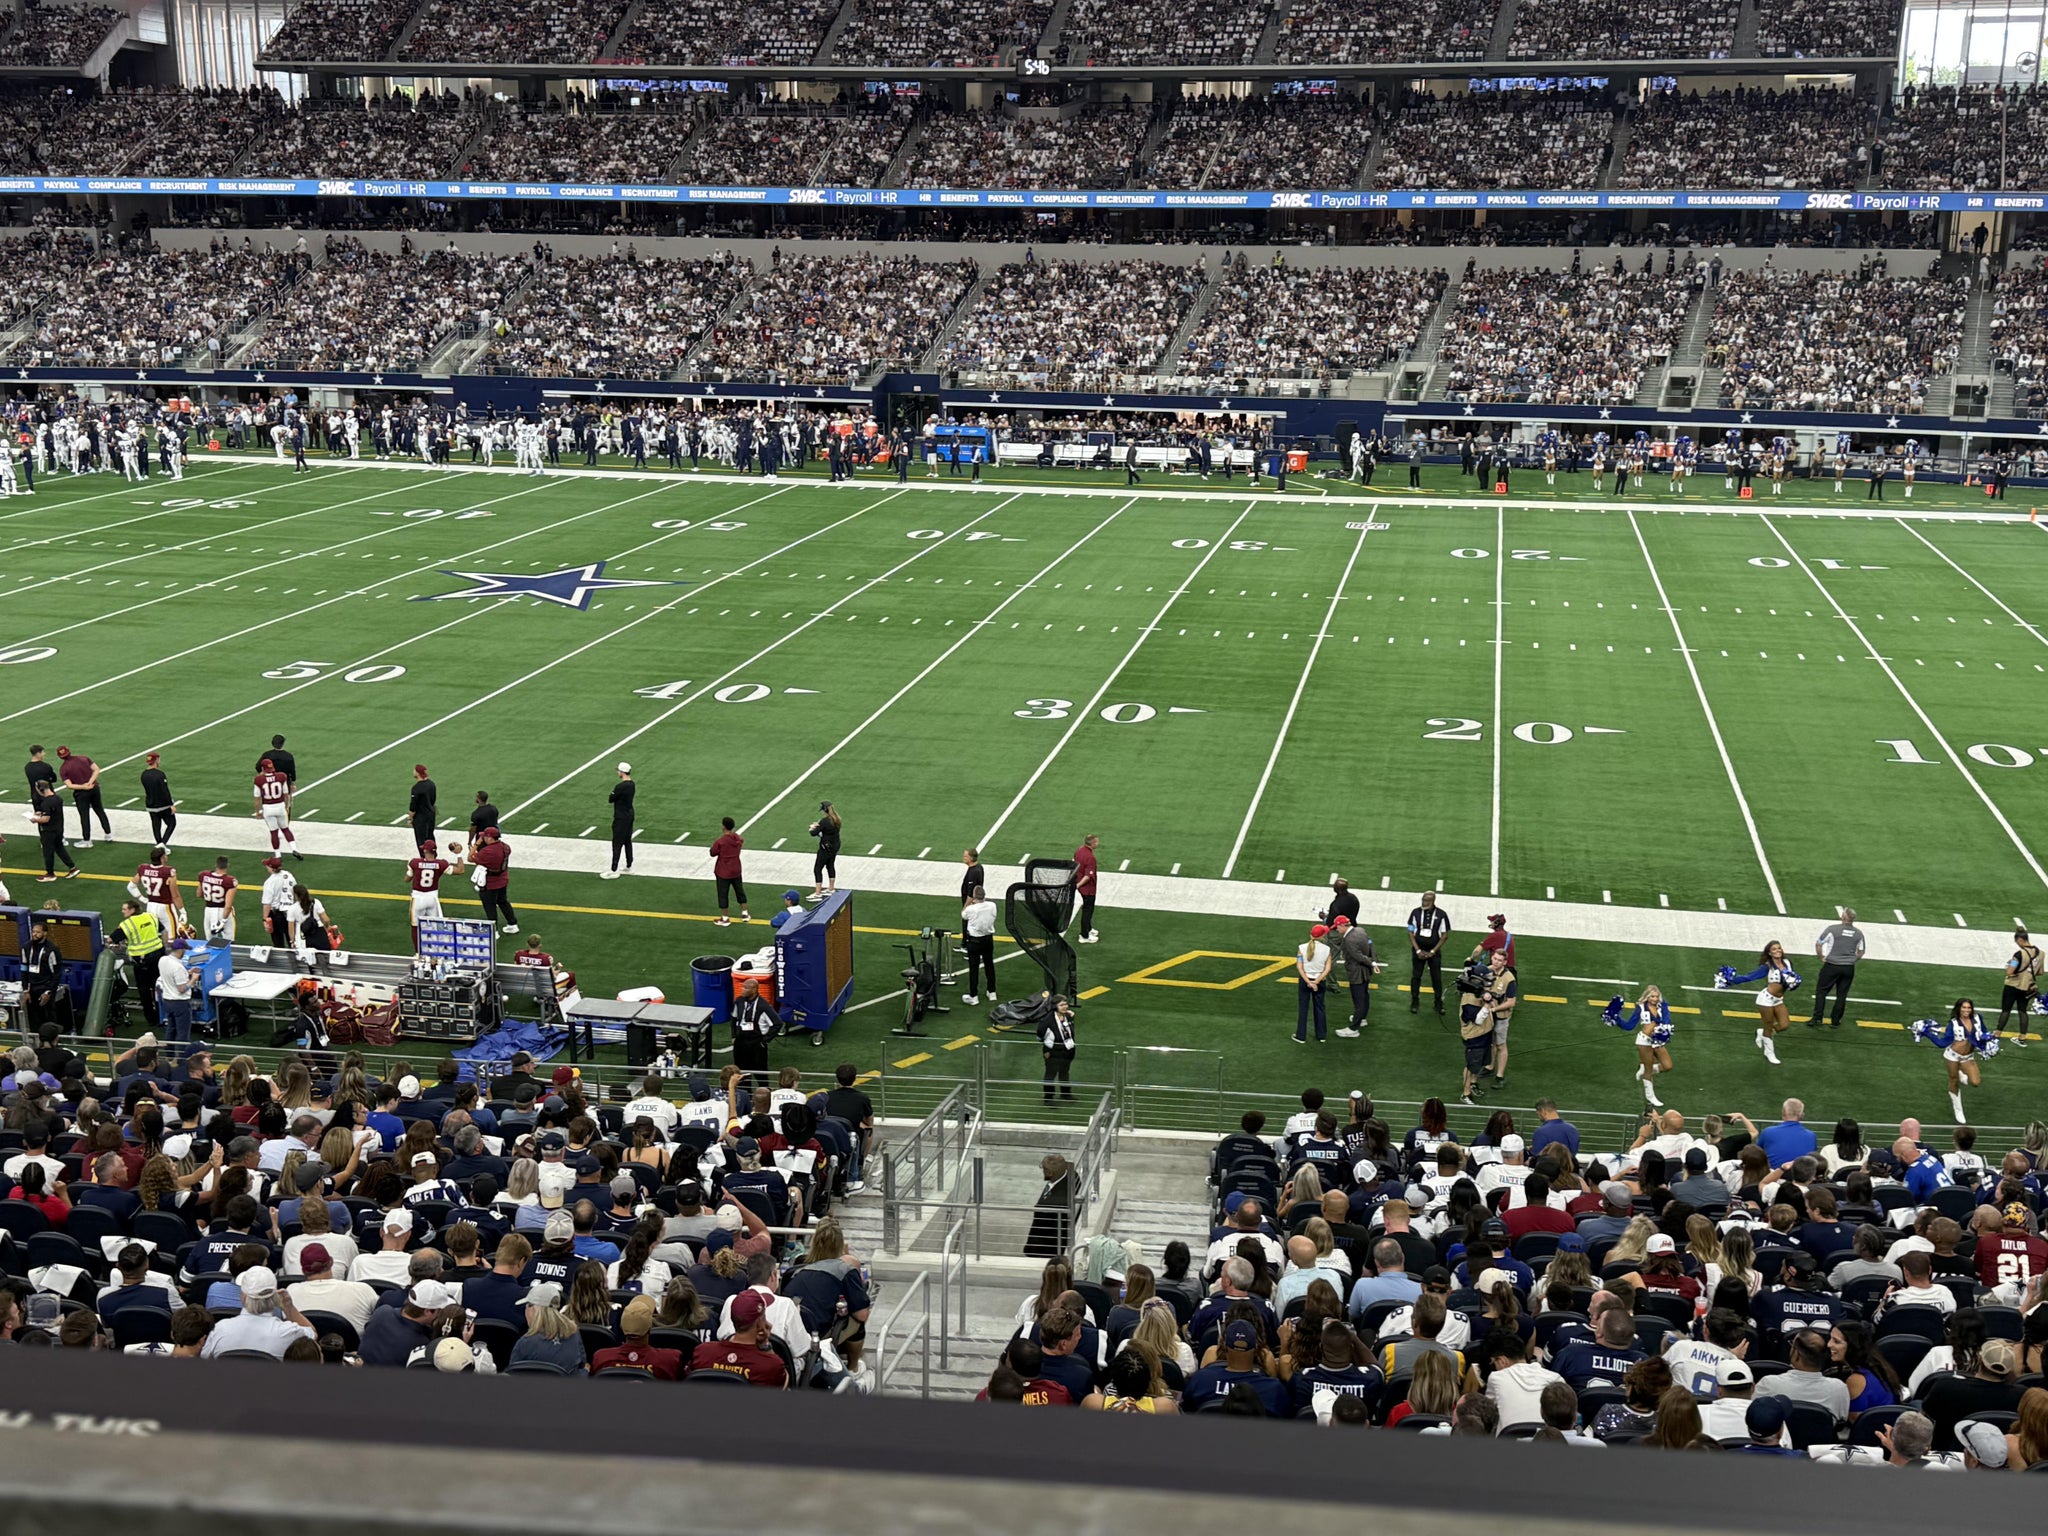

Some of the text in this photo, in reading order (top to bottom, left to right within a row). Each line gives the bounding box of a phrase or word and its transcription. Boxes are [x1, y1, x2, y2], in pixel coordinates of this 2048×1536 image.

[43, 181, 80, 189] PAYROLL
[88, 182, 142, 190] COMPLIANCE
[150, 182, 208, 190] RECRUITMENT
[219, 183, 236, 191] RISK
[237, 183, 296, 191] MANAGEMENT
[317, 182, 357, 195] SWBC
[447, 185, 767, 200] HR BENEFITS PAYROLL COMPLIANCE RECRUITMENT RISK MANAGEMENT
[788, 189, 828, 203] SWBC
[919, 194, 1249, 205] HR BENEFITS PAYROLL COMPLIANCE RECRUITMENT RISK MANAGEMENT
[1270, 194, 1313, 208] SWBC
[1411, 195, 1781, 205] HR BENEFITS PAYROLL COMPLIANCE RECRUITMENT RISK MANAGEMENT
[1805, 194, 1854, 209] SWBC
[1967, 198, 2044, 207] HR BENEFITS
[1290, 457, 1298, 467] G
[262, 782, 282, 799] 10
[420, 870, 435, 888] 8
[202, 882, 225, 903] 82
[694, 1106, 713, 1116] LAMB
[2001, 1239, 2028, 1251] TAYLOR
[535, 1262, 567, 1277] DOWNS
[1997, 1253, 2030, 1285] 21
[1783, 1301, 1830, 1315] GUERRERO
[1690, 1348, 1725, 1366] AIKM
[1023, 1391, 1049, 1406] NIELS
